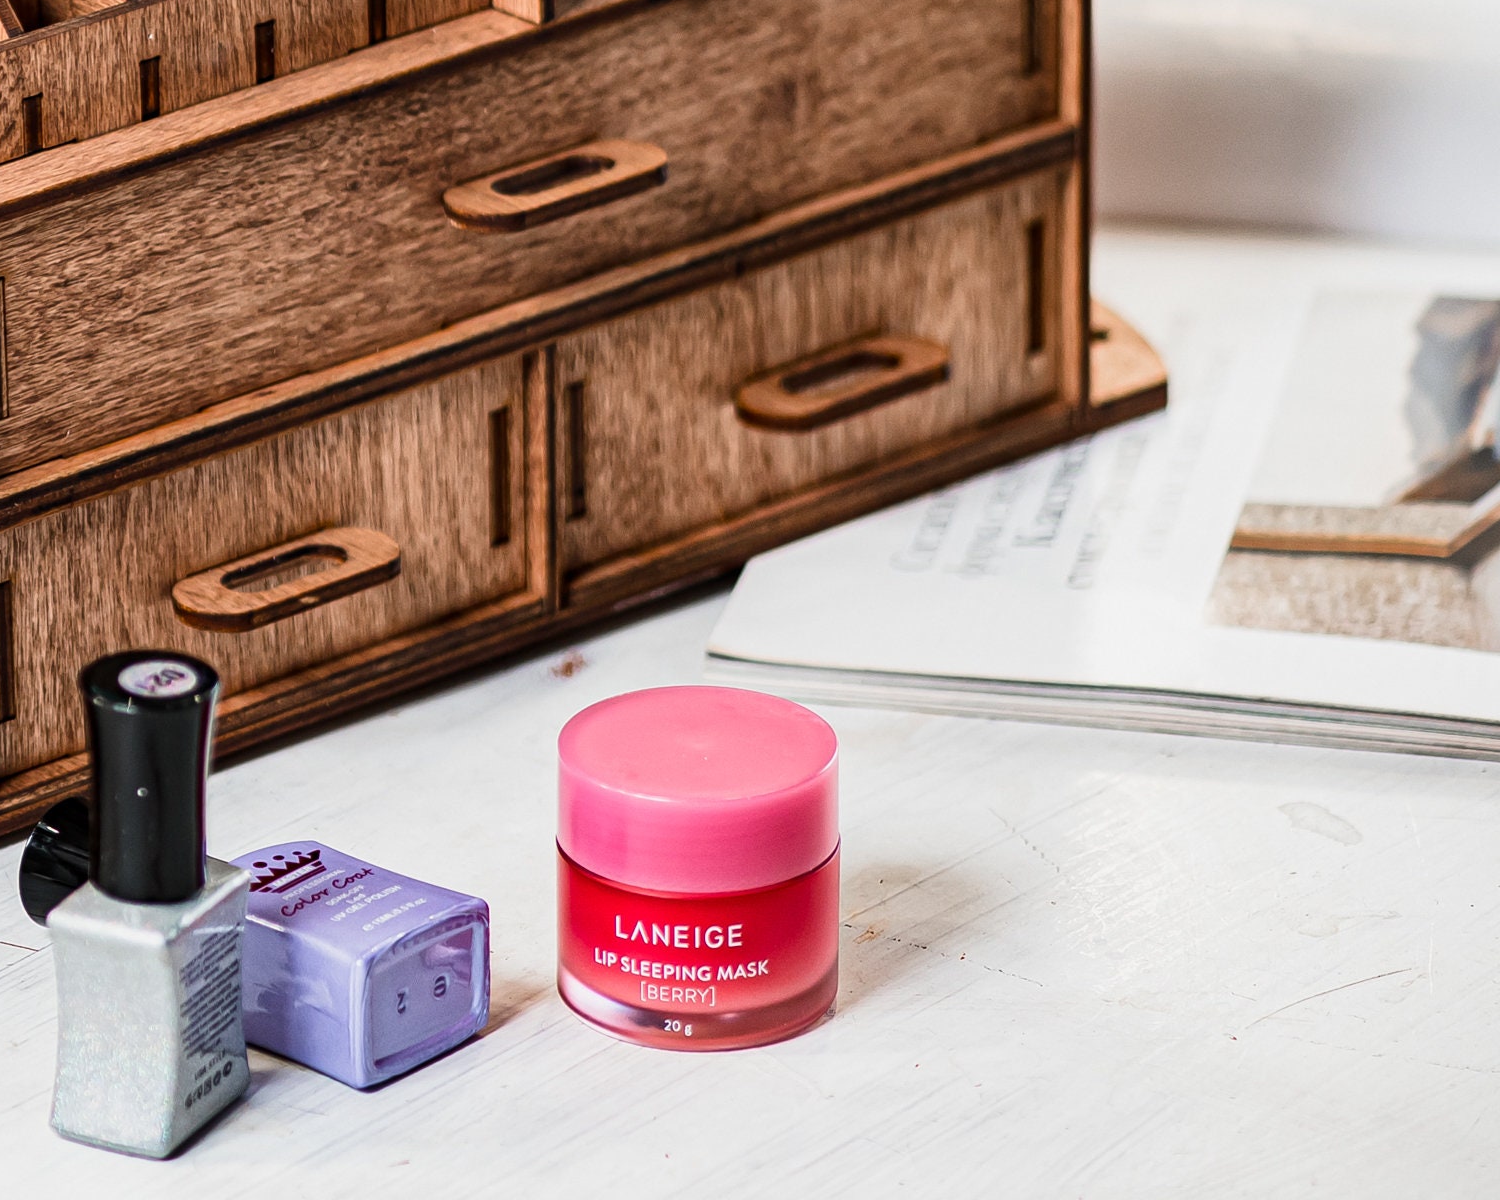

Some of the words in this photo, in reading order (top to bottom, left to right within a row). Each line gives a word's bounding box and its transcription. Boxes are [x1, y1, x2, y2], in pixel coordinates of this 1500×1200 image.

[281, 888, 329, 917] Color
[332, 867, 376, 890] Coat
[282, 868, 346, 901] PROFESSIONAL
[330, 912, 346, 923] UV
[345, 901, 366, 916] GEL
[366, 884, 403, 905] POLISH
[614, 914, 744, 950] LANEIGE
[594, 947, 617, 968] LIP
[620, 955, 713, 982] SLEEPING
[716, 959, 770, 982] MASK
[639, 980, 717, 1007] [BERRY]
[663, 1018, 681, 1033] 20
[684, 1021, 693, 1037] g
